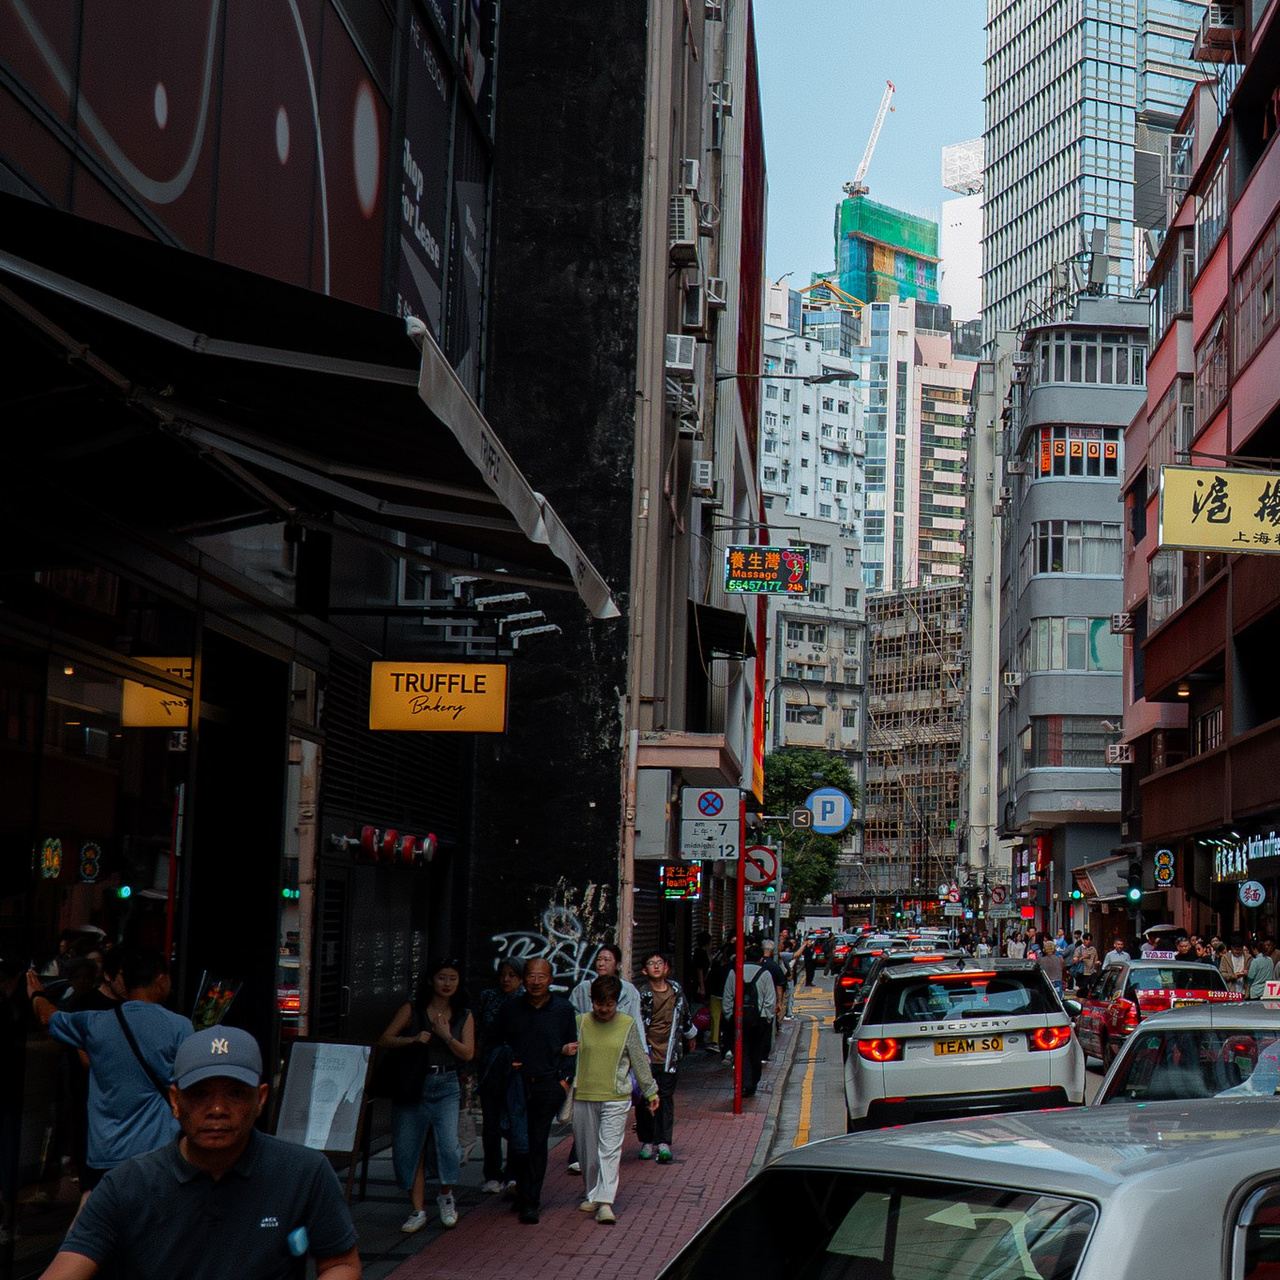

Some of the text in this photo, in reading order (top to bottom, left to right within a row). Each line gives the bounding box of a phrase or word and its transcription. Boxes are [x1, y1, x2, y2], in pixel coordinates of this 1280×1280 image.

[730, 551, 780, 570] 養生灣
[390, 673, 486, 693] TRUFFLE
[408, 695, 466, 720] Bakery
[718, 823, 727, 836] 7
[718, 845, 735, 857] 12
[920, 1020, 1010, 1031] DISCOVERY
[938, 1038, 1000, 1053] TEAM SO
